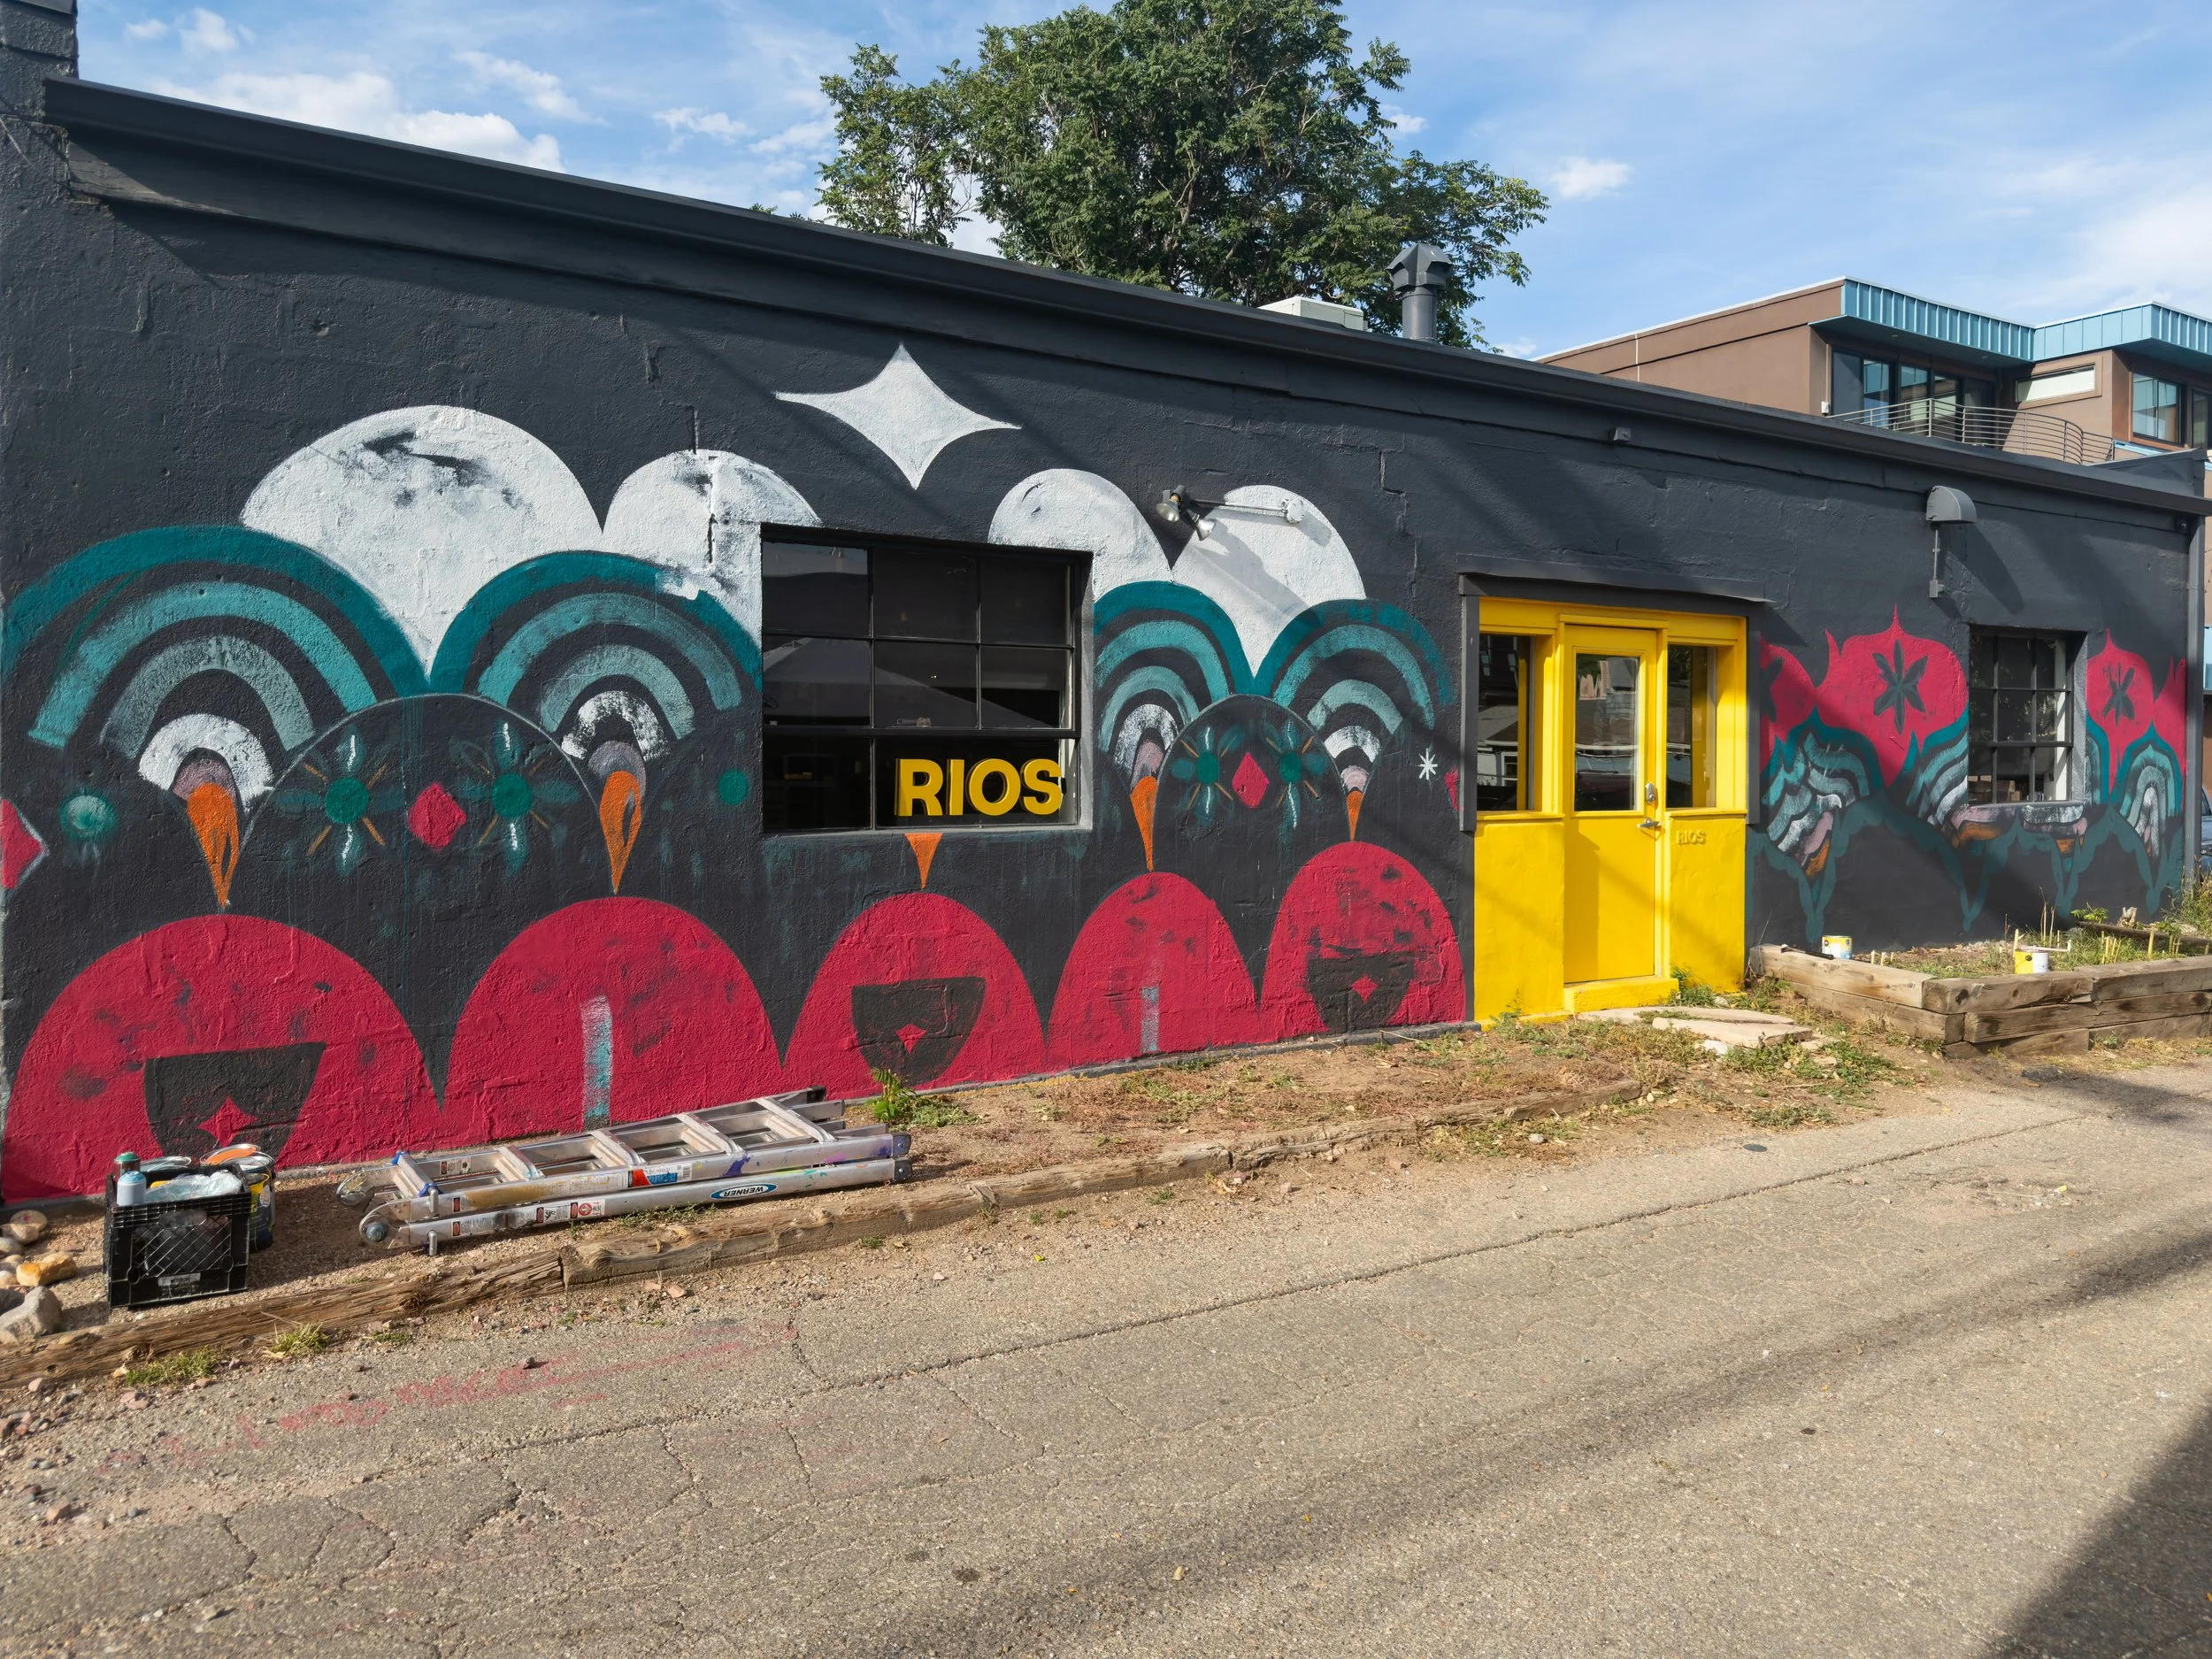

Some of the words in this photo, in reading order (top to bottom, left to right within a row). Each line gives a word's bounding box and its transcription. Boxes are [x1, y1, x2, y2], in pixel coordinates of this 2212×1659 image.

[895, 758, 1063, 816] RIOS
[1677, 830, 1706, 844] RIOS
[724, 1187, 764, 1196] WERNER
